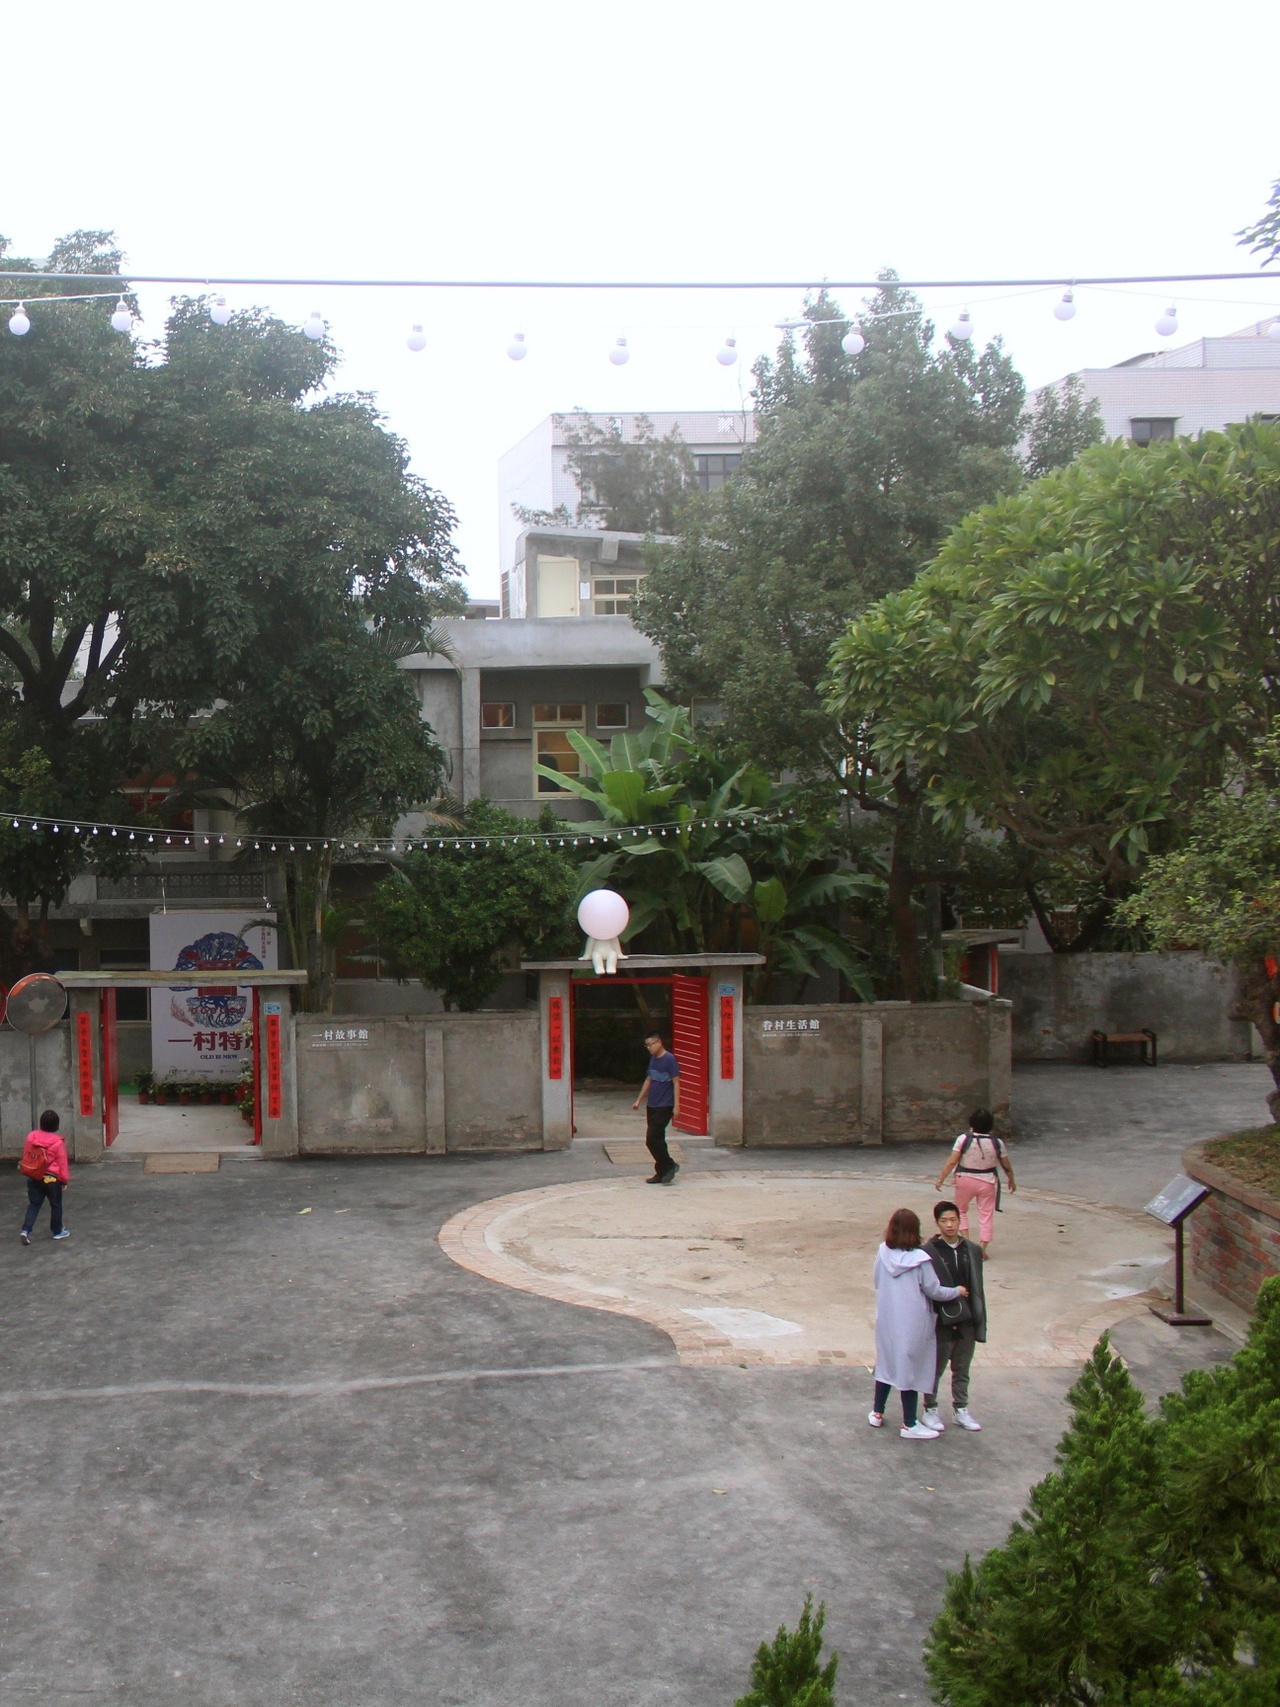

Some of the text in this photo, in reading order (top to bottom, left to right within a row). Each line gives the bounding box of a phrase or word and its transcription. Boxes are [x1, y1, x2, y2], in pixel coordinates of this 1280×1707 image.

[763, 1019, 820, 1030] 眷村生活館
[312, 1029, 369, 1041] 一村故事館
